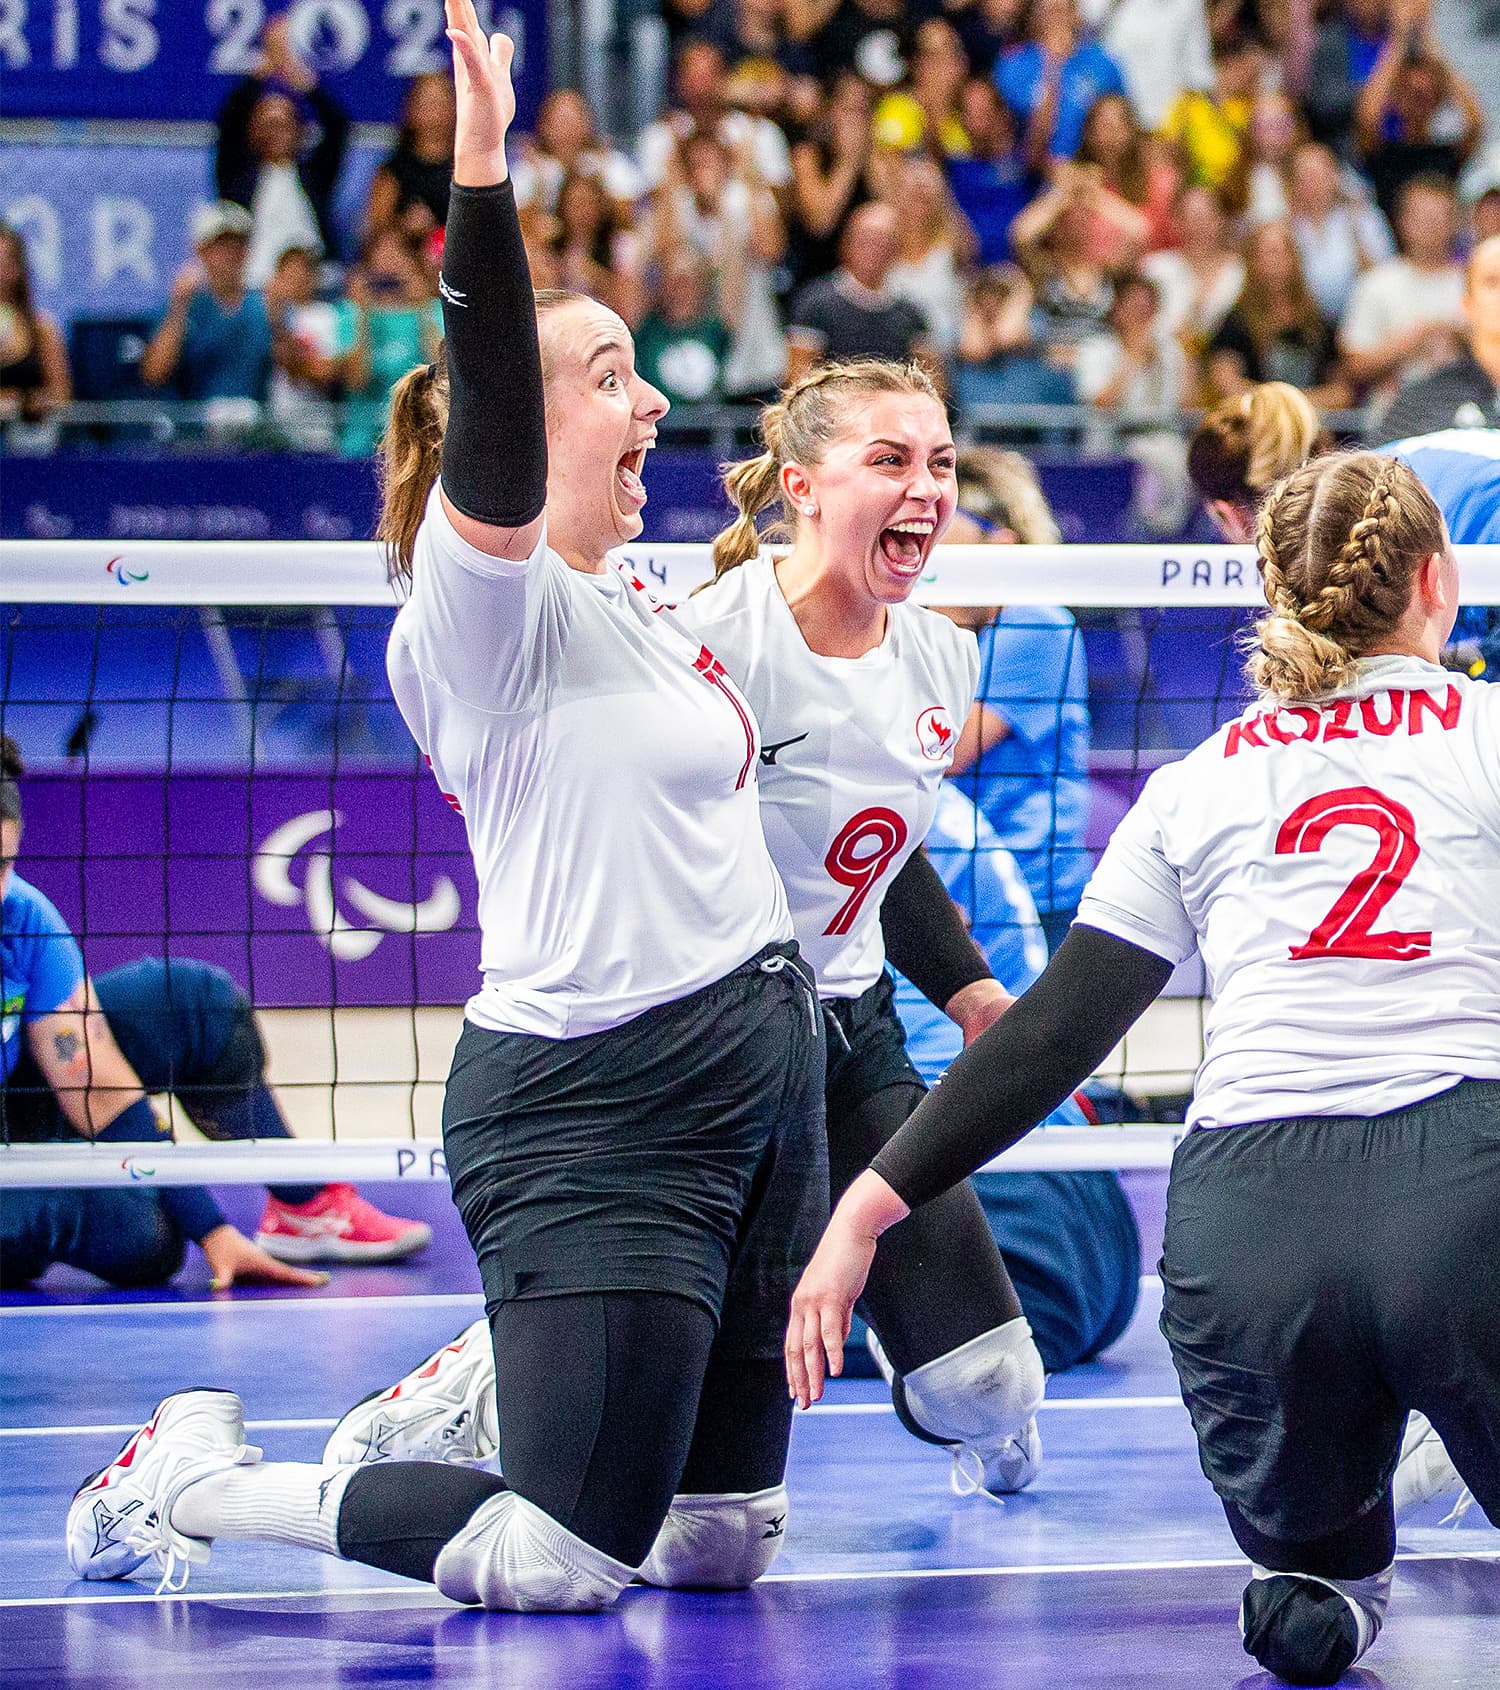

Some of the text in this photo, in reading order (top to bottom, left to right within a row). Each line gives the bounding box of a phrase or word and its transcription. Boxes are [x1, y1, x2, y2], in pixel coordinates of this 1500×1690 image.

[1223, 683, 1463, 759] KOZUN
[822, 806, 908, 937] 9
[1274, 785, 1433, 961] 2
